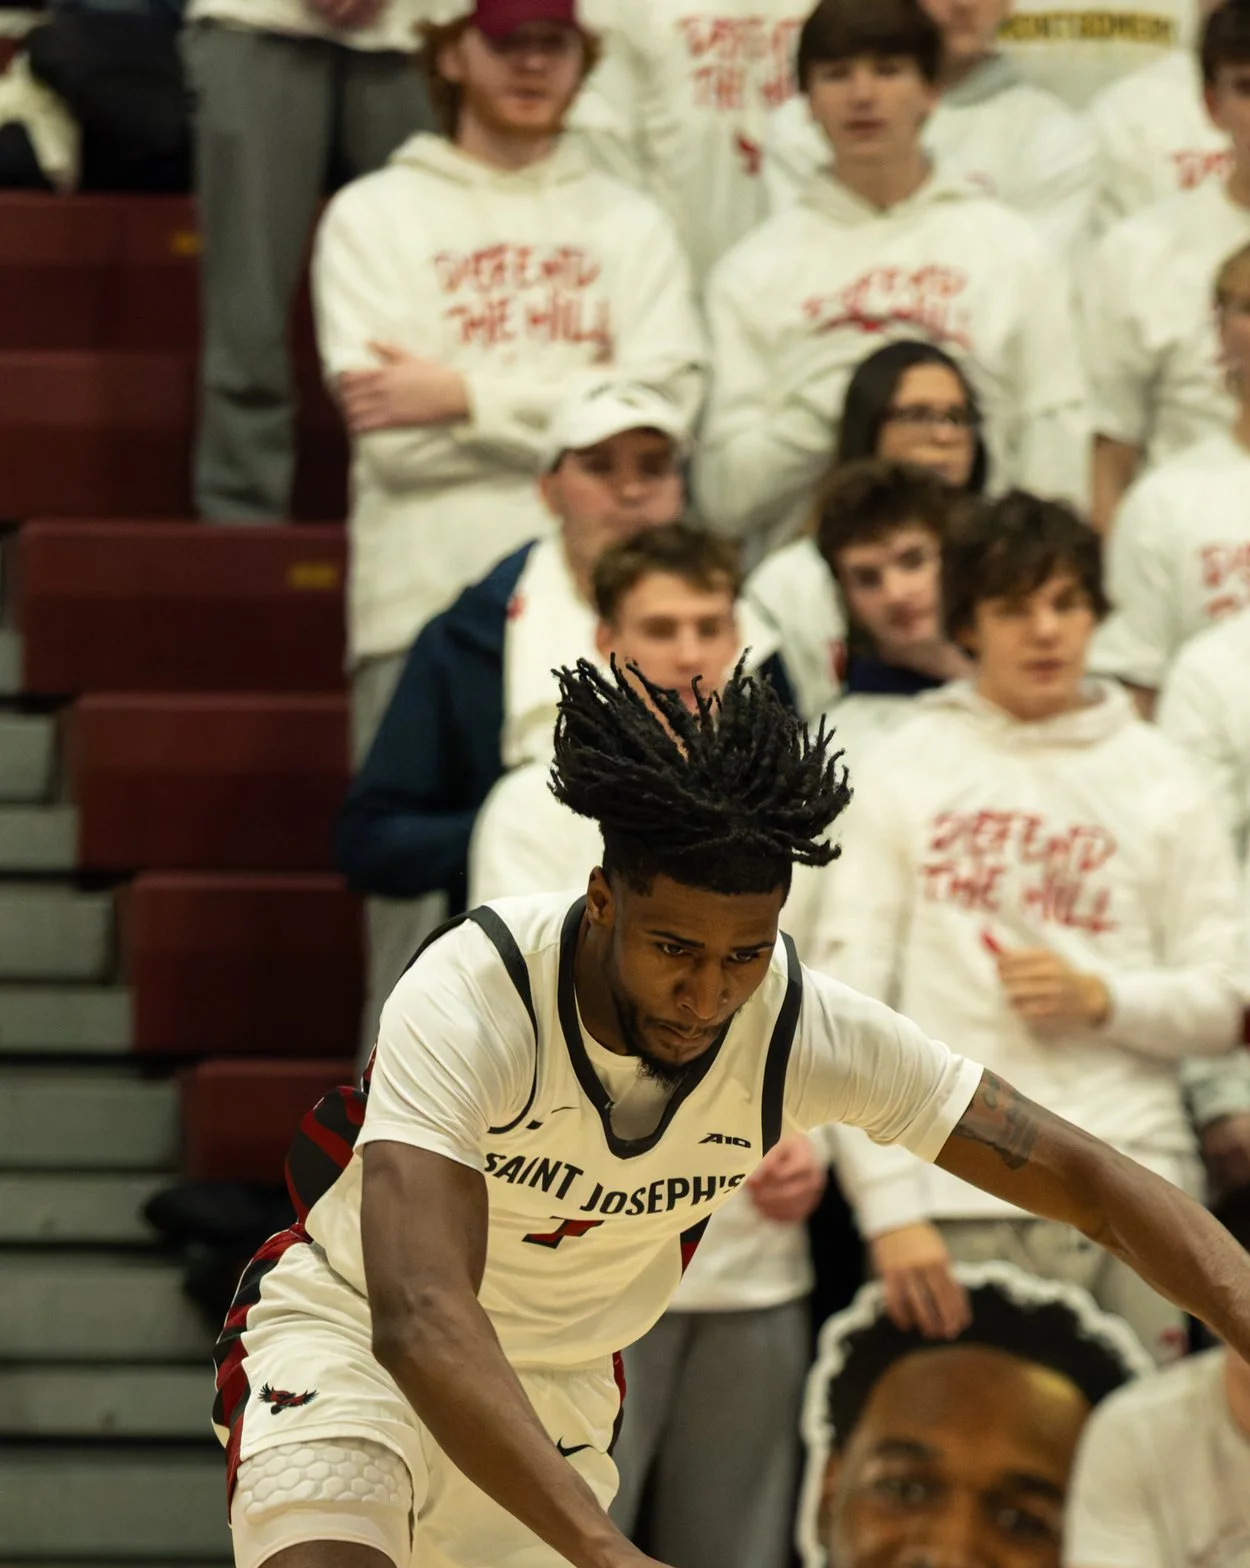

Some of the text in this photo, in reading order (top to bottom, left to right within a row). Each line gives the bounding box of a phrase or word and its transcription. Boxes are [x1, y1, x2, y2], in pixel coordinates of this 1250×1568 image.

[698, 1132, 752, 1149] A10
[484, 1152, 747, 1216] SAINT JOSEPH'S
